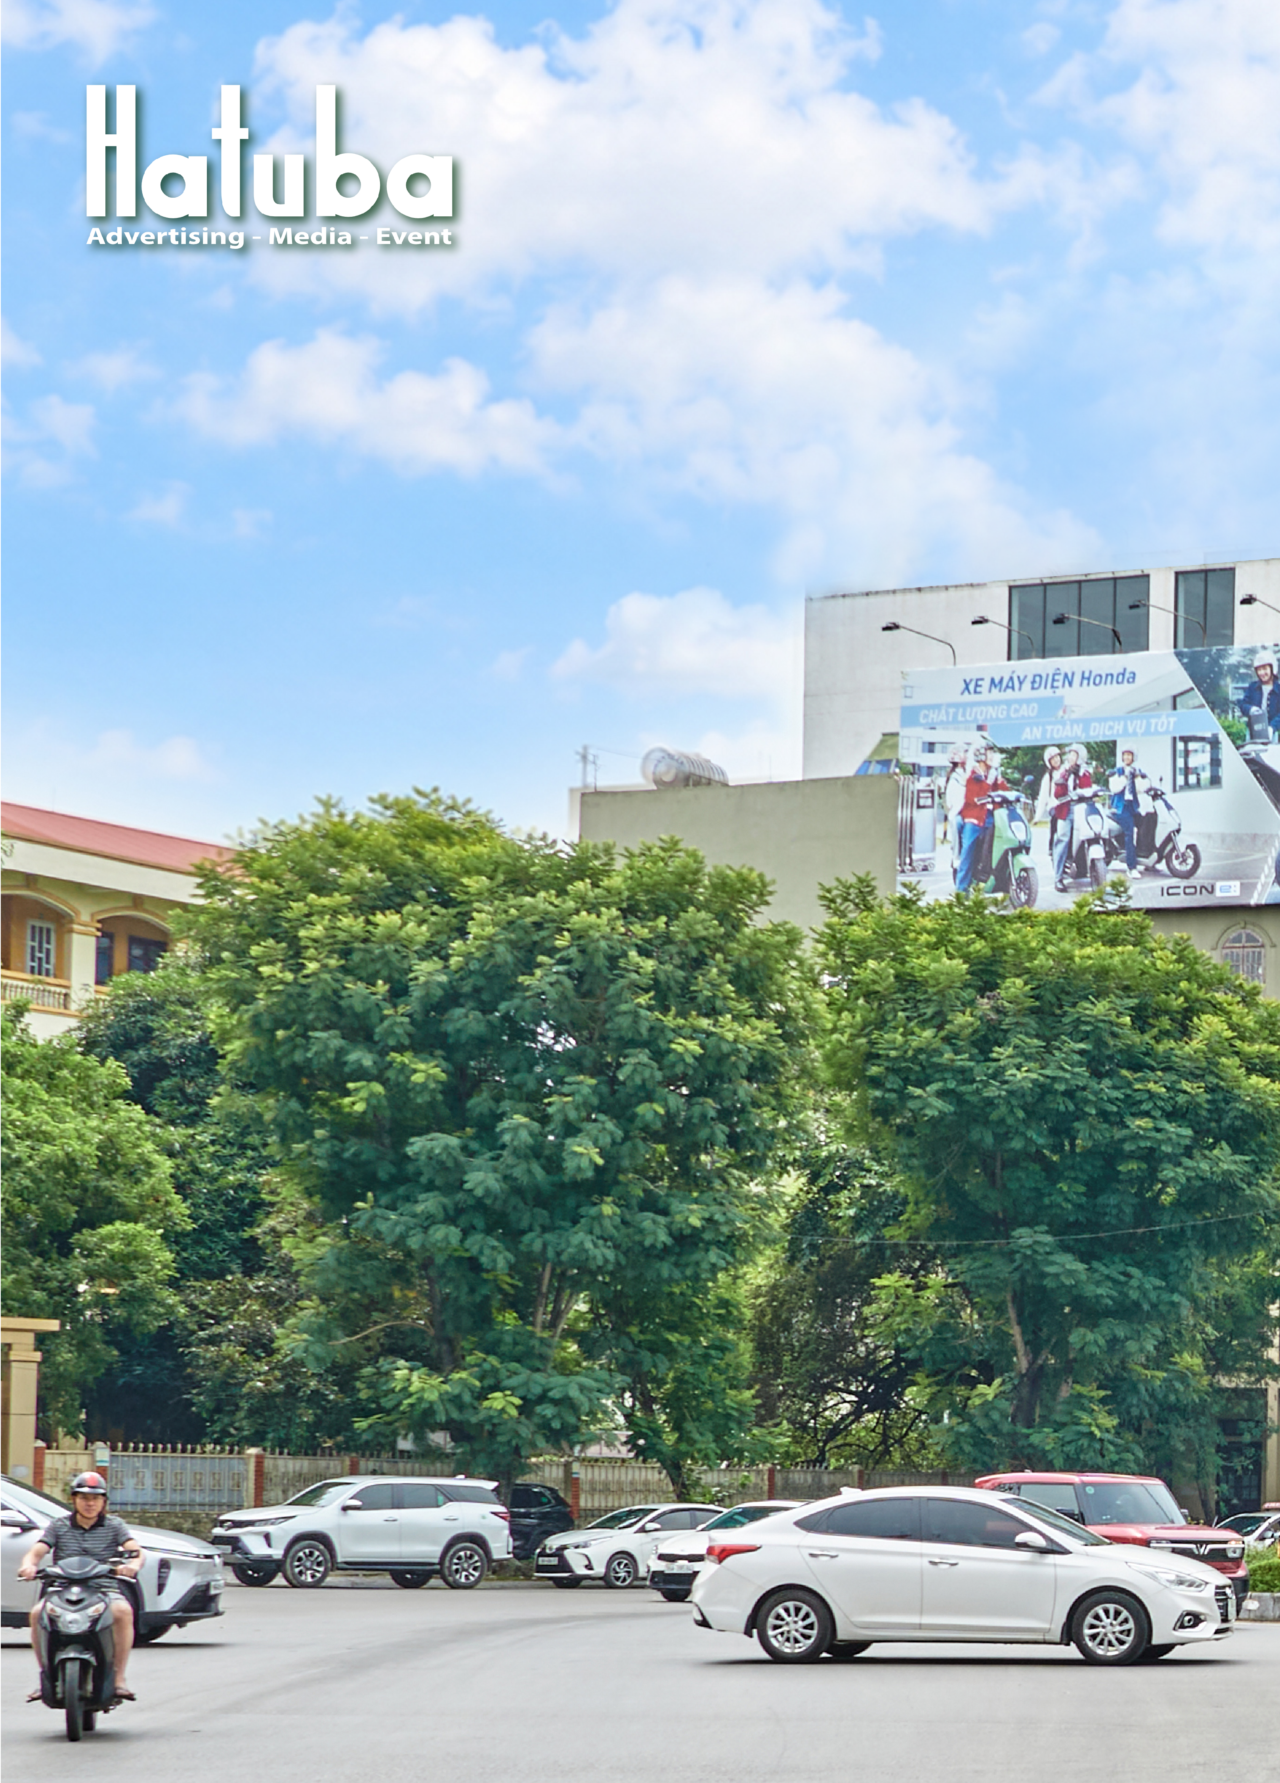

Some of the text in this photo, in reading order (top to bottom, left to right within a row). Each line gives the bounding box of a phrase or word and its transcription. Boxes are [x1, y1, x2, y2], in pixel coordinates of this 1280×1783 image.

[960, 667, 1136, 696] XE MÁY ĐIỆN Honda
[920, 702, 1038, 724] CHẤT LƯỢNG CAO
[1021, 714, 1177, 740] AN TOÀN, DỊCH VỤ TỐT
[1161, 884, 1214, 897] ICON
